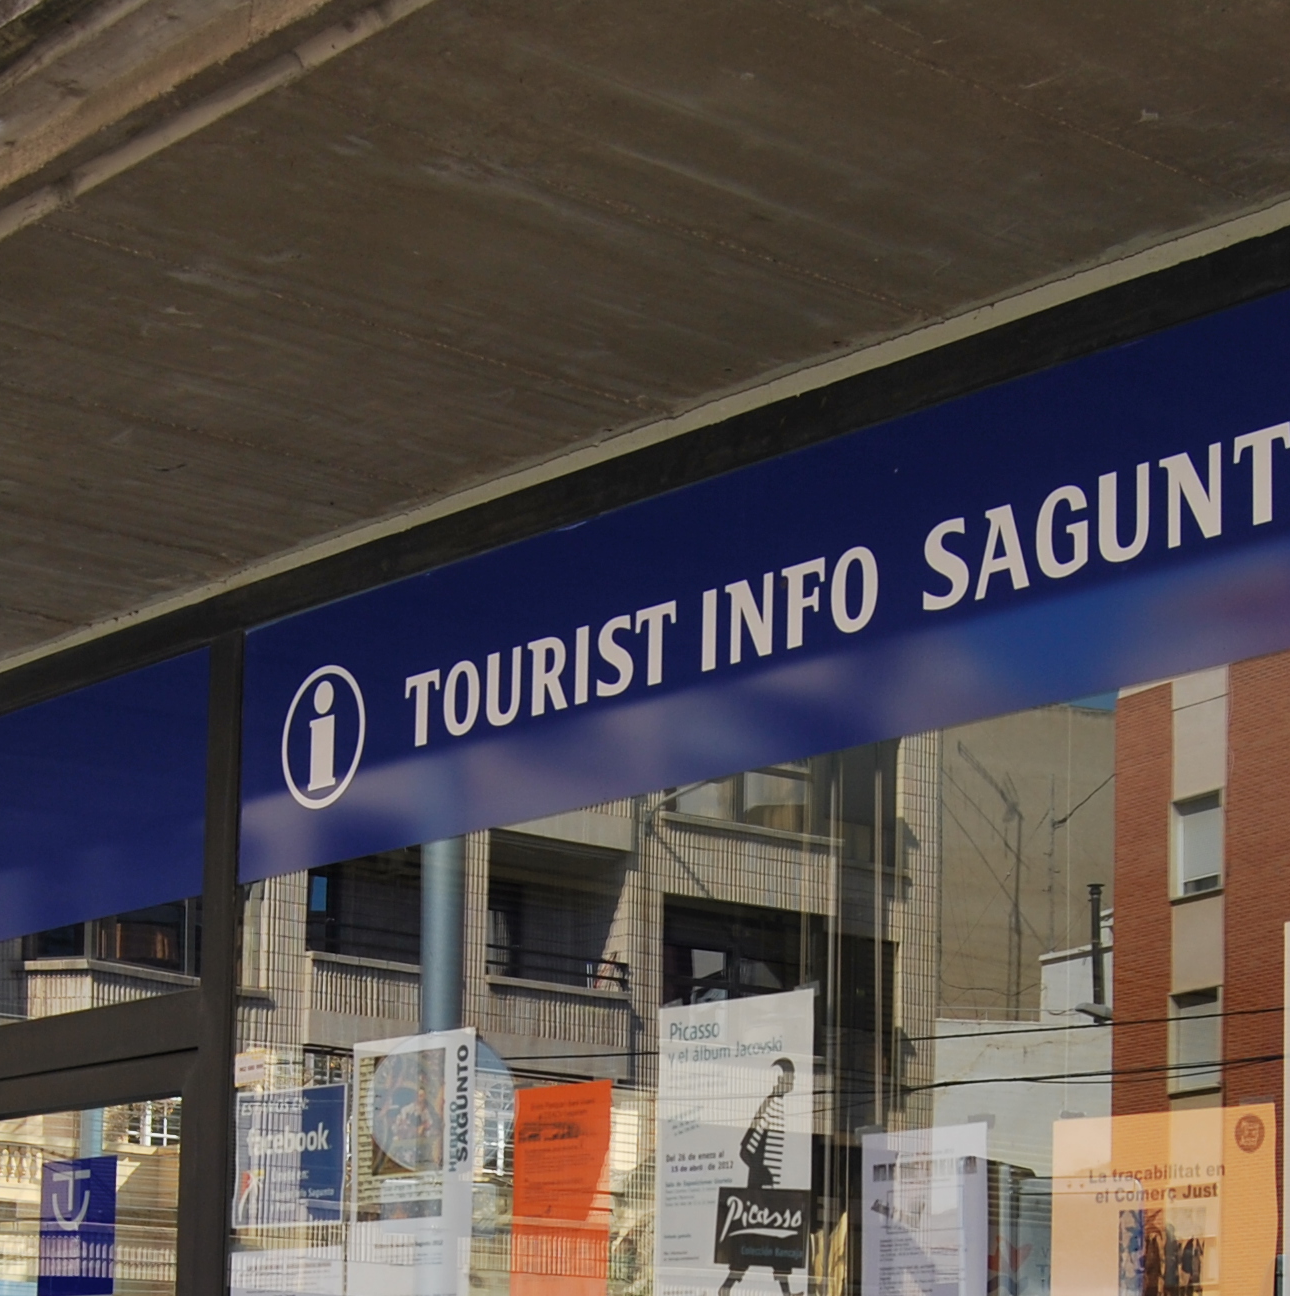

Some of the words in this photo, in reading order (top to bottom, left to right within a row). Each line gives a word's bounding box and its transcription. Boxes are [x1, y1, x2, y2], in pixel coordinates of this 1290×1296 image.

[403, 600, 678, 748] TOURIST
[701, 544, 880, 673] INFO
[669, 1022, 720, 1040] Picasso
[456, 1044, 469, 1162] SAGUNTO
[247, 1121, 329, 1157] facebook
[718, 1161, 734, 1170] 2012
[1088, 1169, 1107, 1184] La
[1206, 1164, 1226, 1178] en
[1114, 1186, 1177, 1204] Comerç
[1182, 1182, 1219, 1199] Just
[719, 1195, 802, 1243] Picasso
